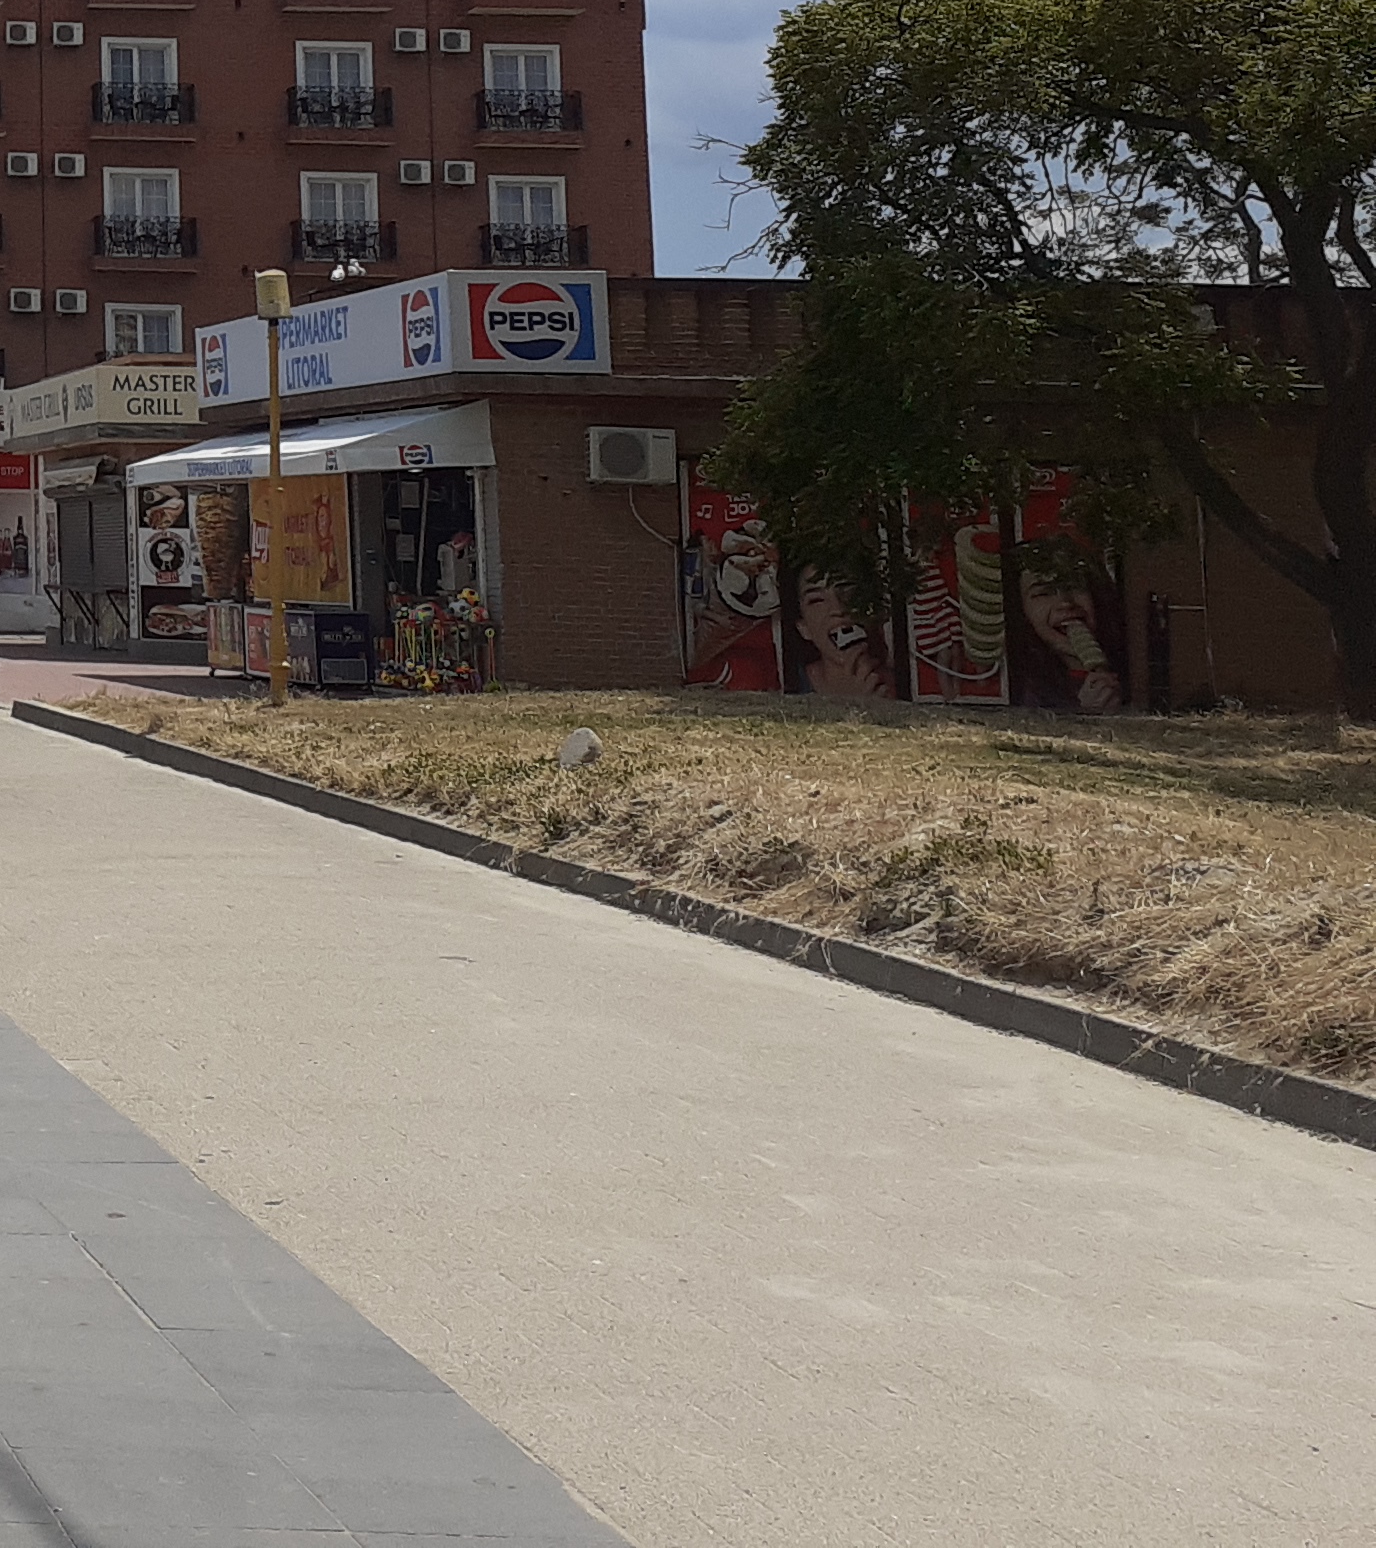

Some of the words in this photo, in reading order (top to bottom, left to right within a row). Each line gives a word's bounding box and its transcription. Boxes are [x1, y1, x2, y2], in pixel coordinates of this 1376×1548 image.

[280, 305, 349, 350] PERMARKET
[407, 315, 435, 339] PEPSI
[488, 311, 576, 332] PEPSI
[112, 374, 197, 392] MASTER
[285, 352, 333, 390] LITORAL
[126, 397, 184, 416] GRILL
[251, 521, 269, 564] Lay
